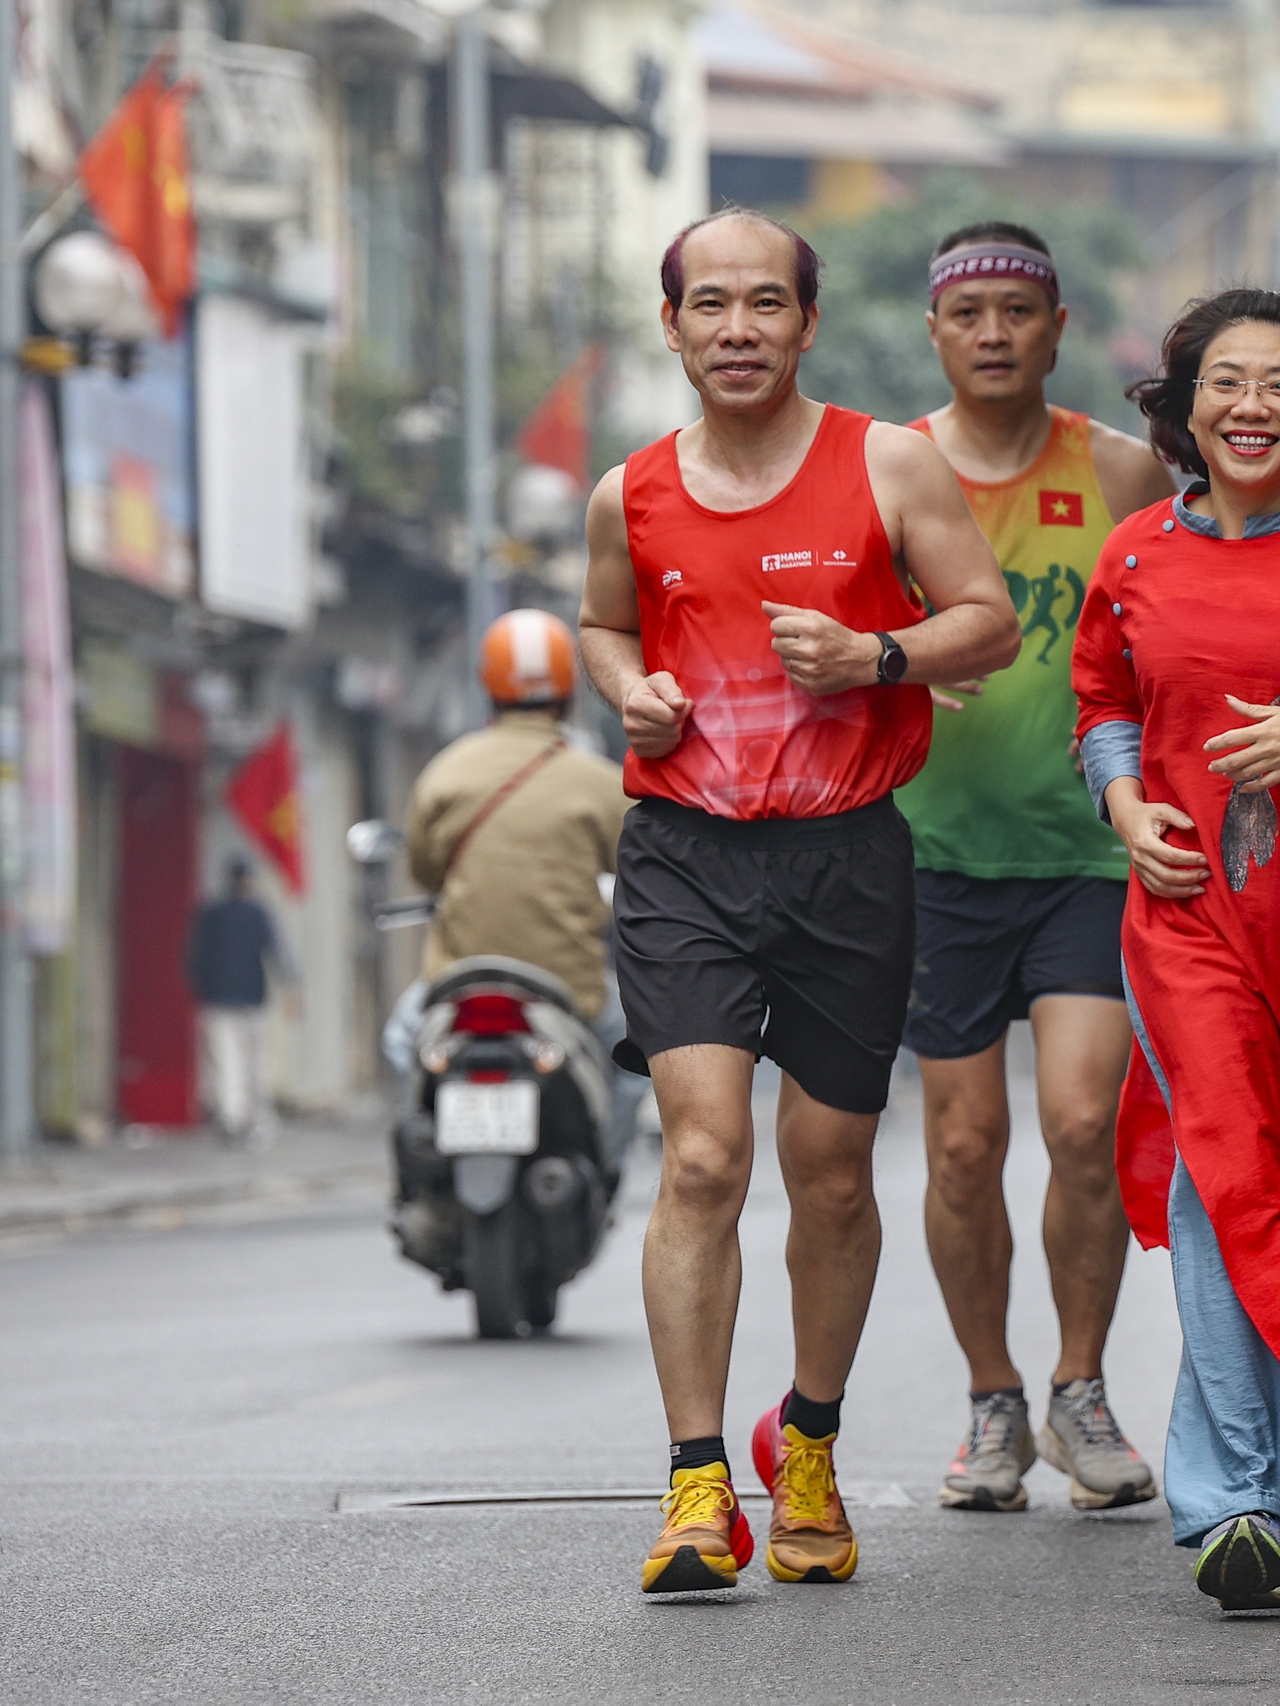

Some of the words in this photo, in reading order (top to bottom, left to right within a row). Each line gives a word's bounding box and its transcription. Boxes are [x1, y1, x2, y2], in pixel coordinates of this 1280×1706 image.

[930, 257, 1053, 289] MPRESSPORT
[780, 550, 812, 562] HANOI
[780, 561, 813, 569] MARATHON
